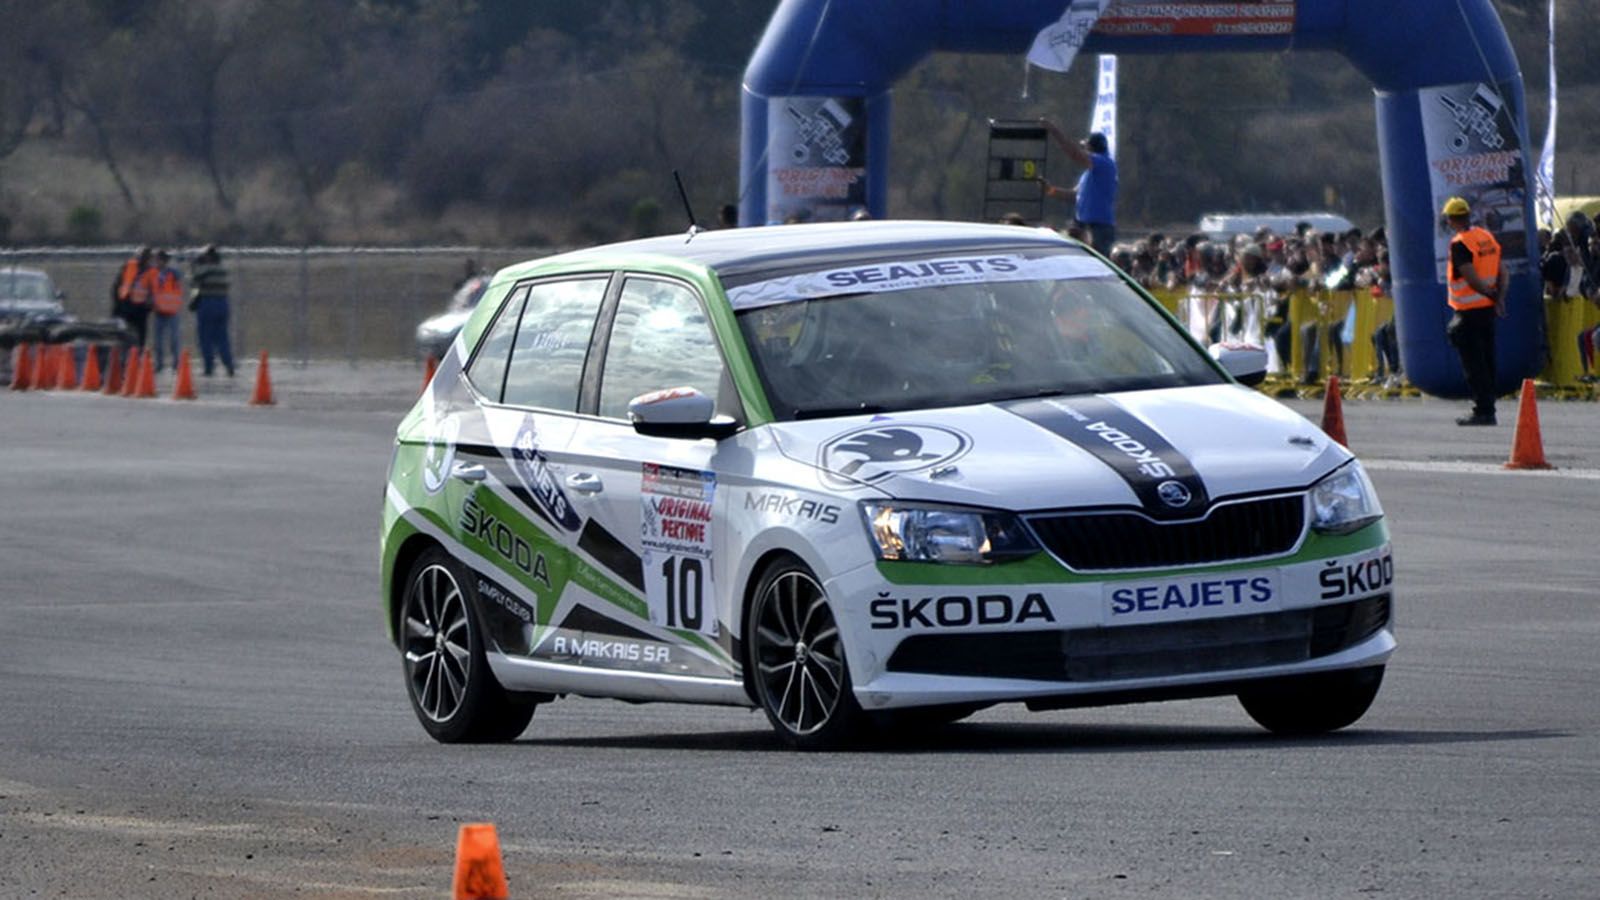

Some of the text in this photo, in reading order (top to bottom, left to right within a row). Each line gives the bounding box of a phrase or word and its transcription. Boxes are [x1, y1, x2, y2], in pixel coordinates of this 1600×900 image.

[826, 256, 1019, 287] SEAJETS
[1085, 422, 1176, 477] ŠKODA
[658, 497, 712, 523] ORIGINAL
[743, 491, 842, 524] MAKAIS
[459, 489, 552, 592] ŠKODA
[663, 556, 703, 630] 10
[870, 592, 1057, 629] ŠKODA
[1112, 577, 1272, 614] SEAJETS
[571, 638, 640, 660] MAKAIS
